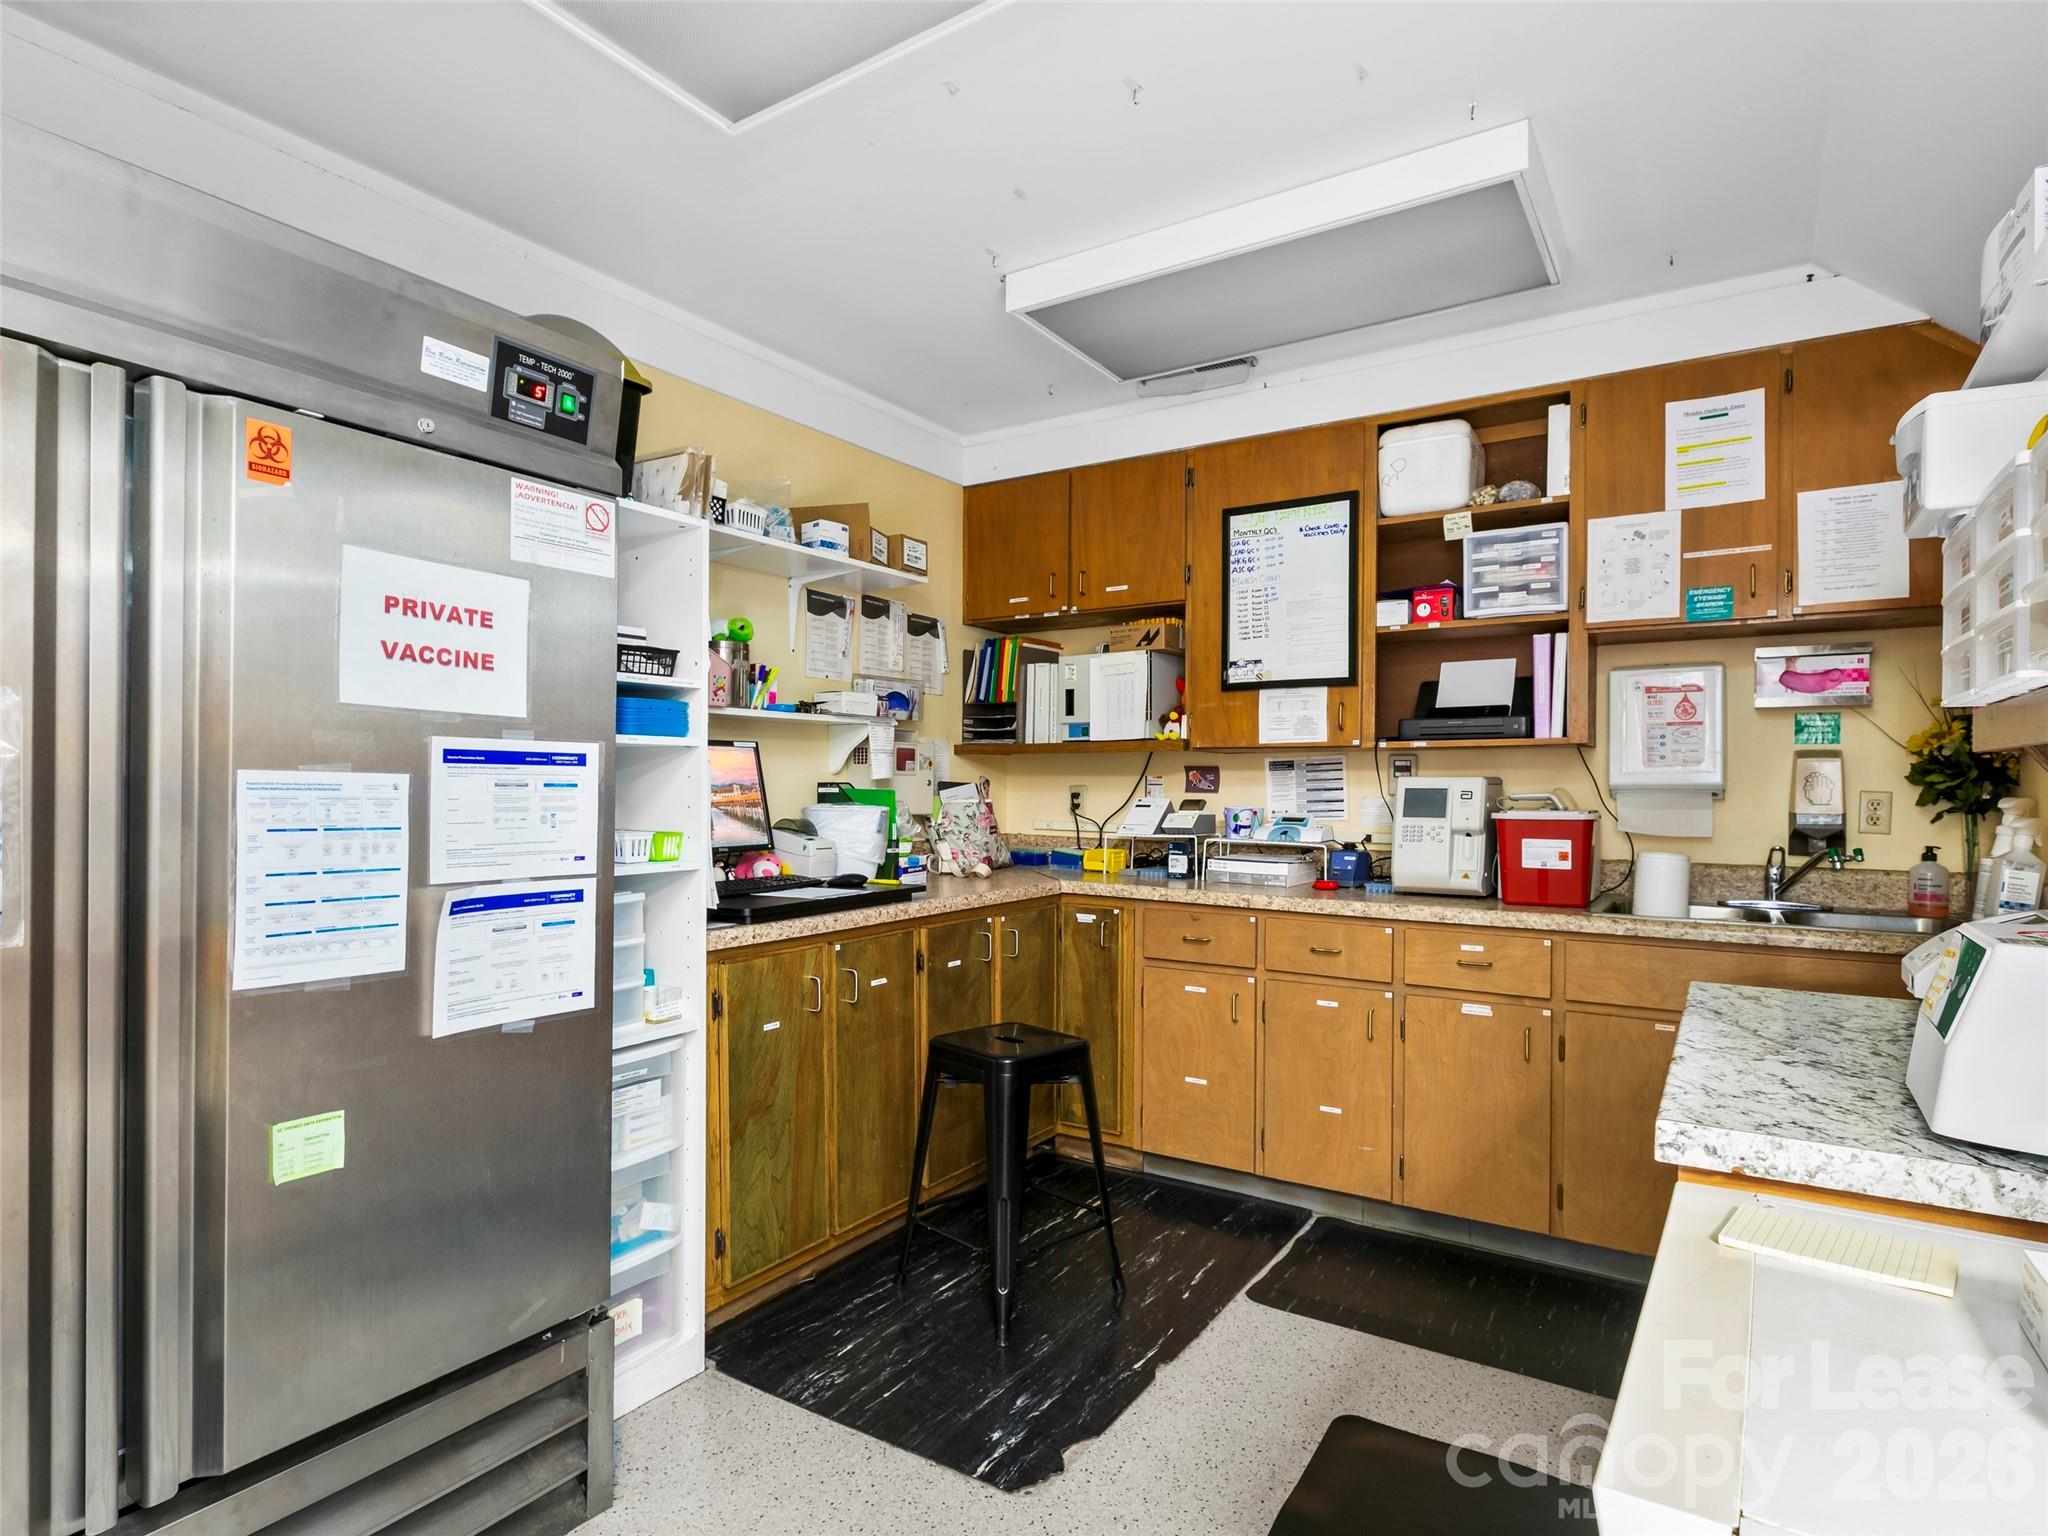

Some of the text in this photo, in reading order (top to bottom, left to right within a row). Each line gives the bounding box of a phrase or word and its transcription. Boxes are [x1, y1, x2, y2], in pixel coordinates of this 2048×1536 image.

[518, 353, 536, 366] TEMP
[540, 362, 558, 376] TECH
[251, 463, 287, 477] BIOHAZARD
[515, 482, 559, 498] WARNING!
[1688, 587, 1732, 596] EMERGENCY
[1693, 594, 1727, 602] EYEWASH
[384, 595, 494, 629] PRIVATE
[380, 640, 495, 671] VACCINE
